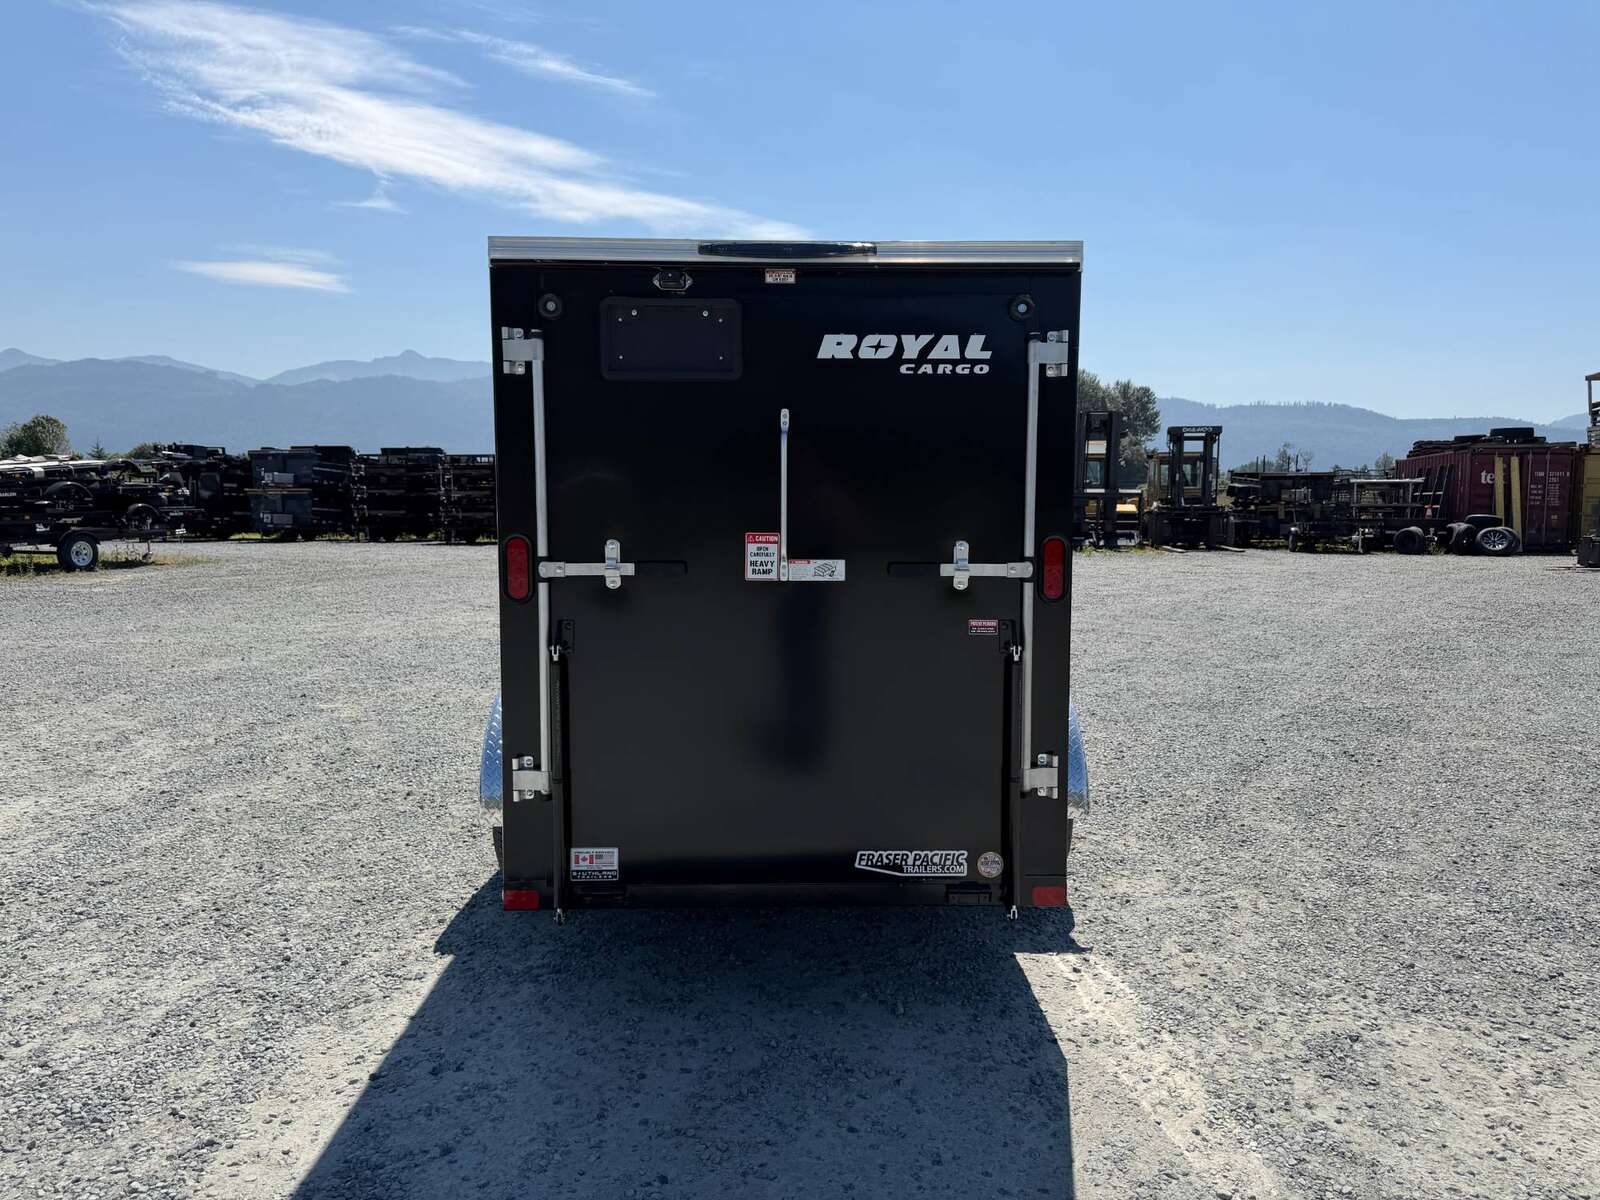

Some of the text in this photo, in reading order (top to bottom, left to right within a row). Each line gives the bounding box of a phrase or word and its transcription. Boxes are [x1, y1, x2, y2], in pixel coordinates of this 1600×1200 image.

[816, 334, 993, 360] ROYAL
[899, 363, 991, 375] CARGO
[857, 852, 909, 866] FRASER
[912, 852, 966, 866] PACIFIC
[903, 865, 964, 873] TRAILERS.COM
